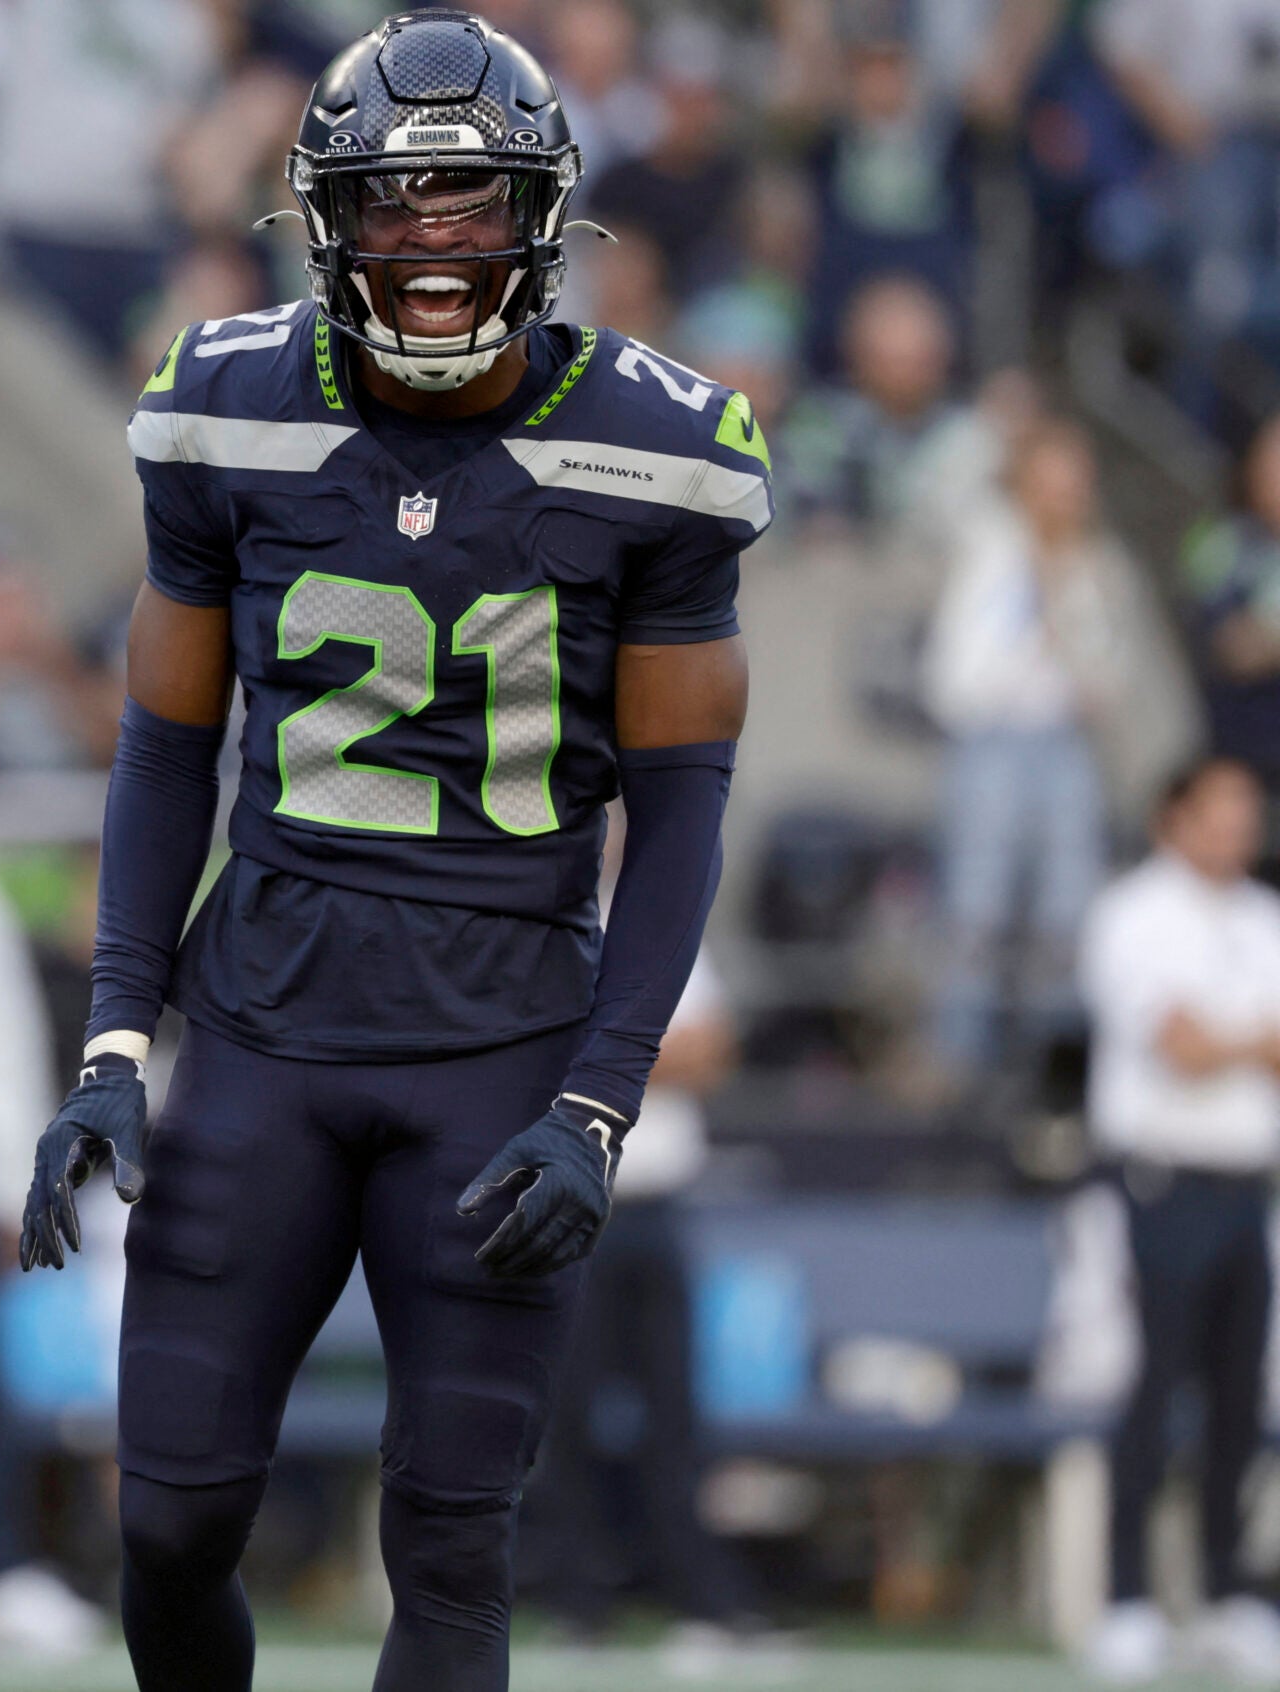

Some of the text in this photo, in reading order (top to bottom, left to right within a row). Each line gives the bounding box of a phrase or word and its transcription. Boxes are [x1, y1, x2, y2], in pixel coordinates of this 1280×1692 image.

[406, 130, 460, 146] SEAHAWKS
[325, 146, 357, 154] OAKLEY
[403, 513, 428, 531] NFL
[273, 570, 561, 836] 21
